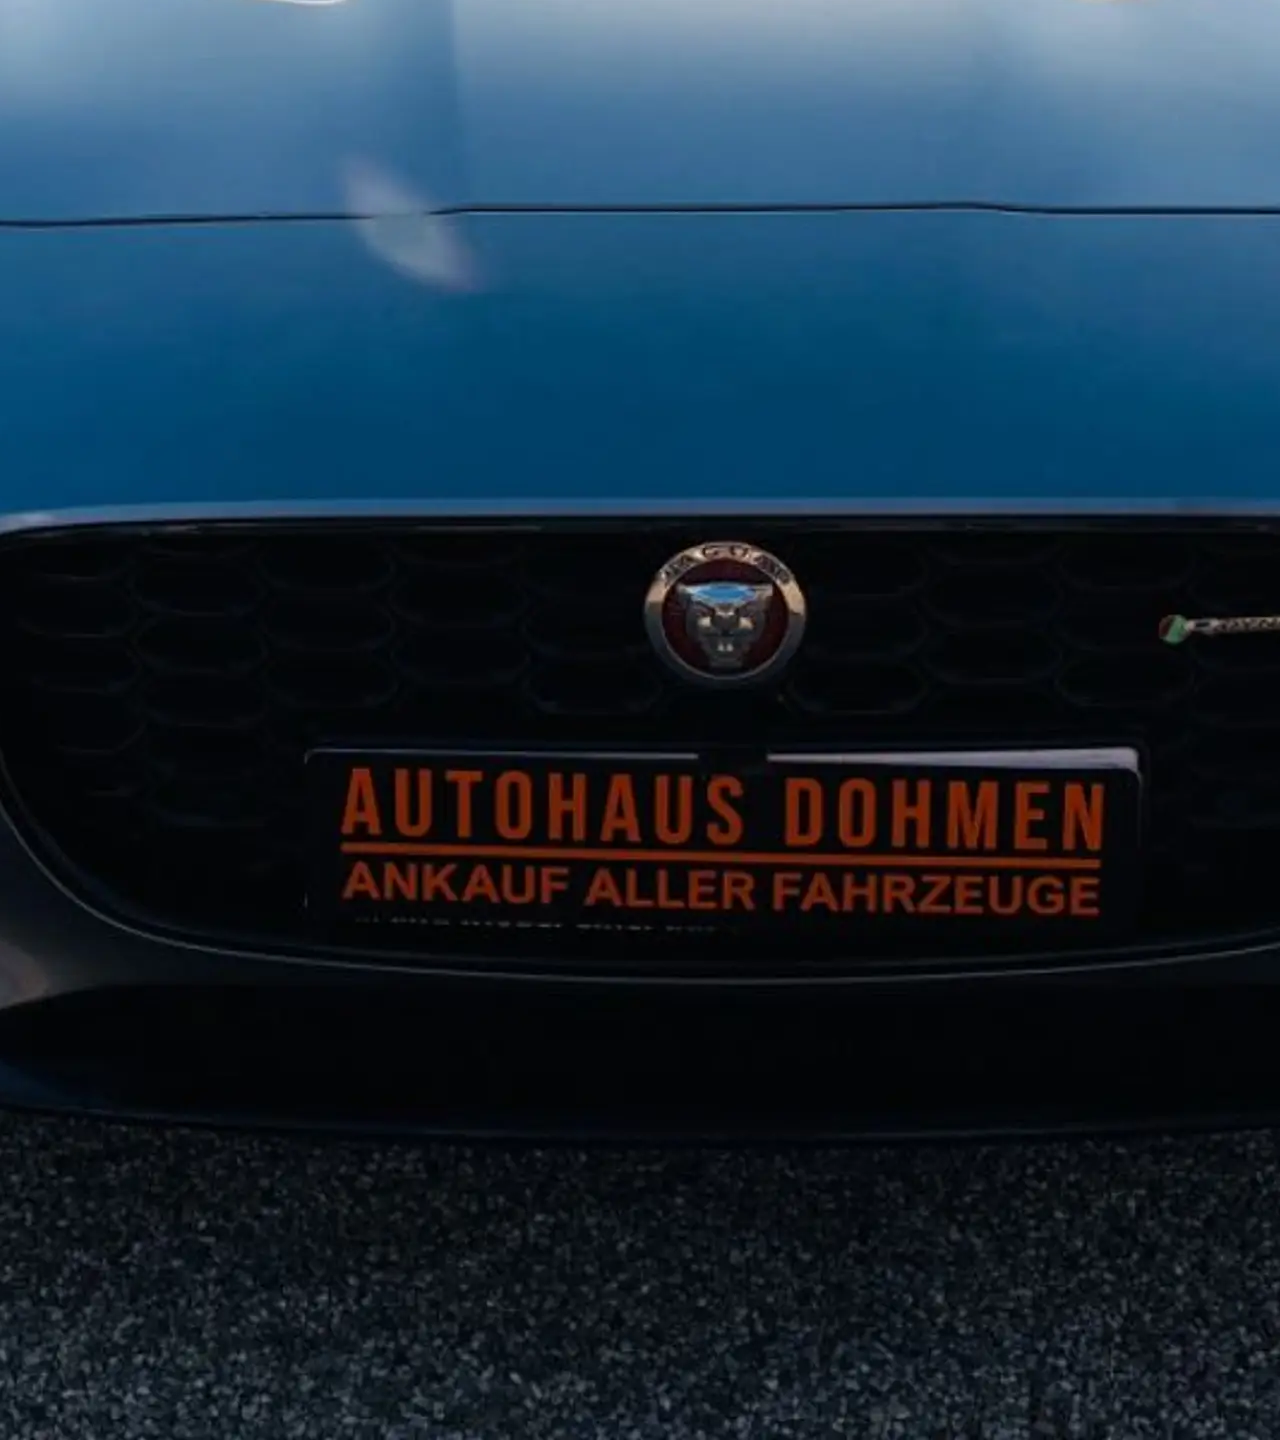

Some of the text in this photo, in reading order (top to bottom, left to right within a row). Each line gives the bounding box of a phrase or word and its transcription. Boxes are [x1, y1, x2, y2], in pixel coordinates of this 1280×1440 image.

[340, 767, 1106, 851] AUTOHAUS DOHMEN
[341, 861, 1101, 917] ANKAUF ALLER FAHRZEUGE
